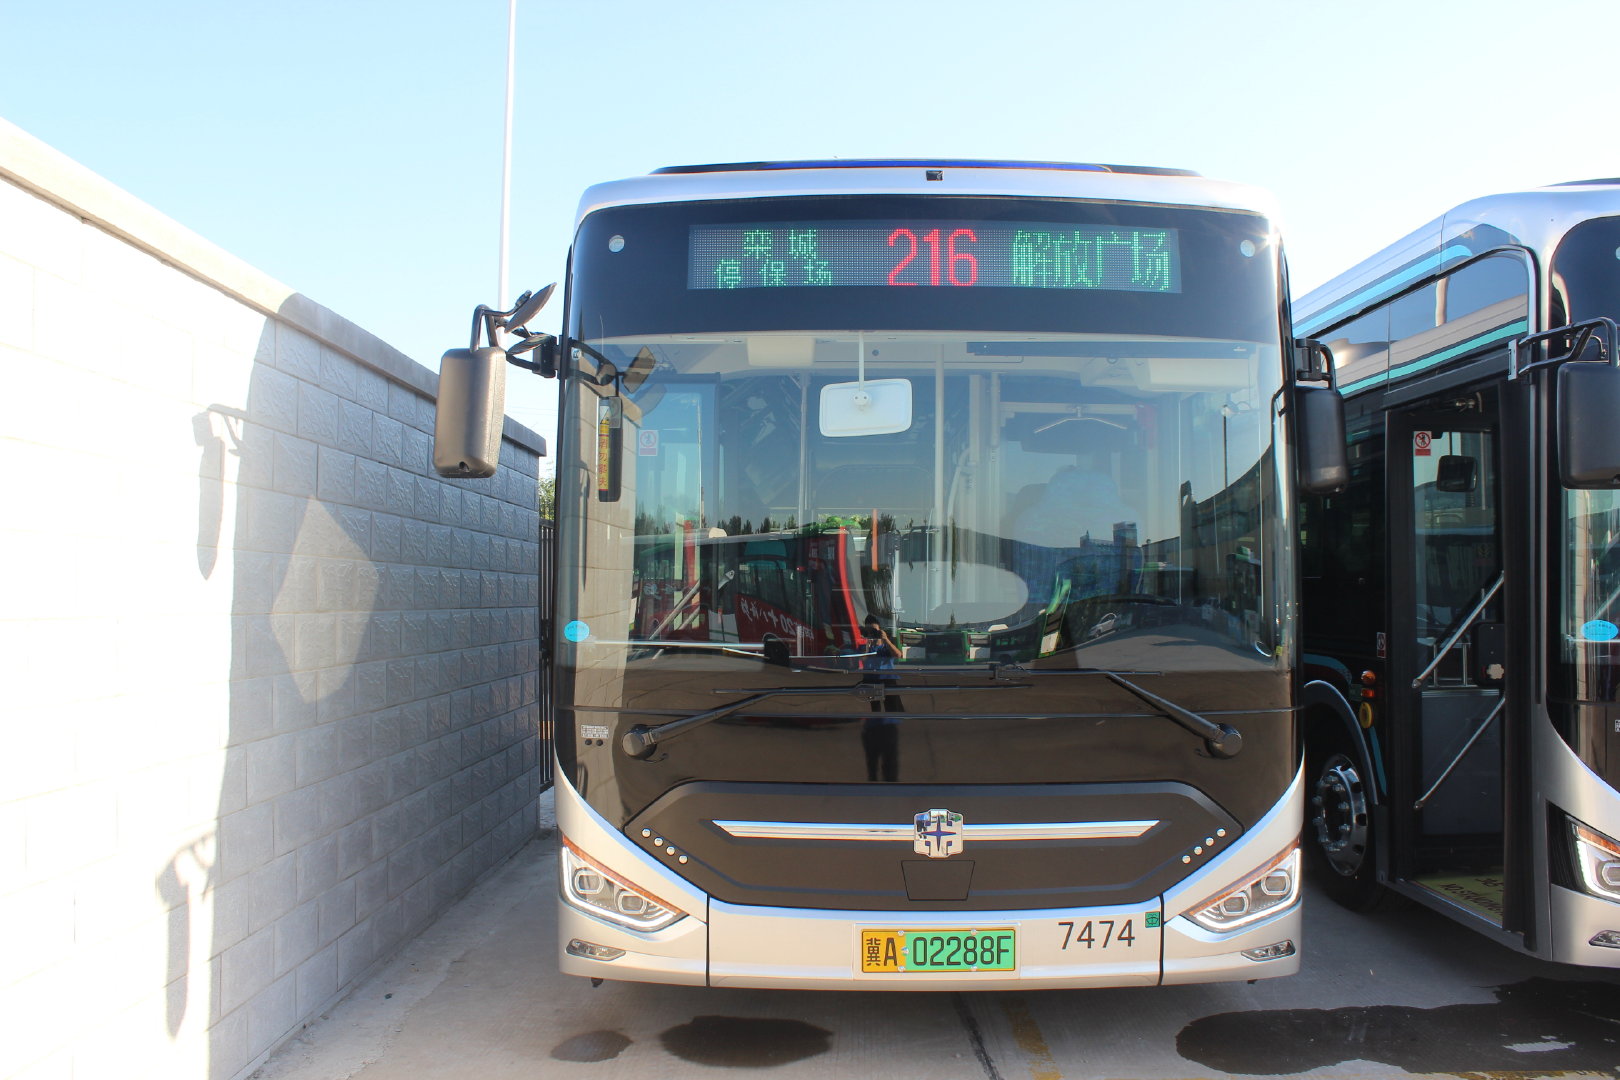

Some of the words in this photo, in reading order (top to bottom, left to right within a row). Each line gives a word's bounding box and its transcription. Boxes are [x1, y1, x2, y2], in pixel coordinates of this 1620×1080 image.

[743, 229, 816, 259] 栾城
[887, 228, 978, 287] 216
[713, 258, 832, 288] 停保场
[1013, 230, 1169, 290] 解放广场
[1058, 919, 1136, 950] 7474
[865, 936, 898, 967] 冀A
[912, 935, 1012, 966] 02288F
